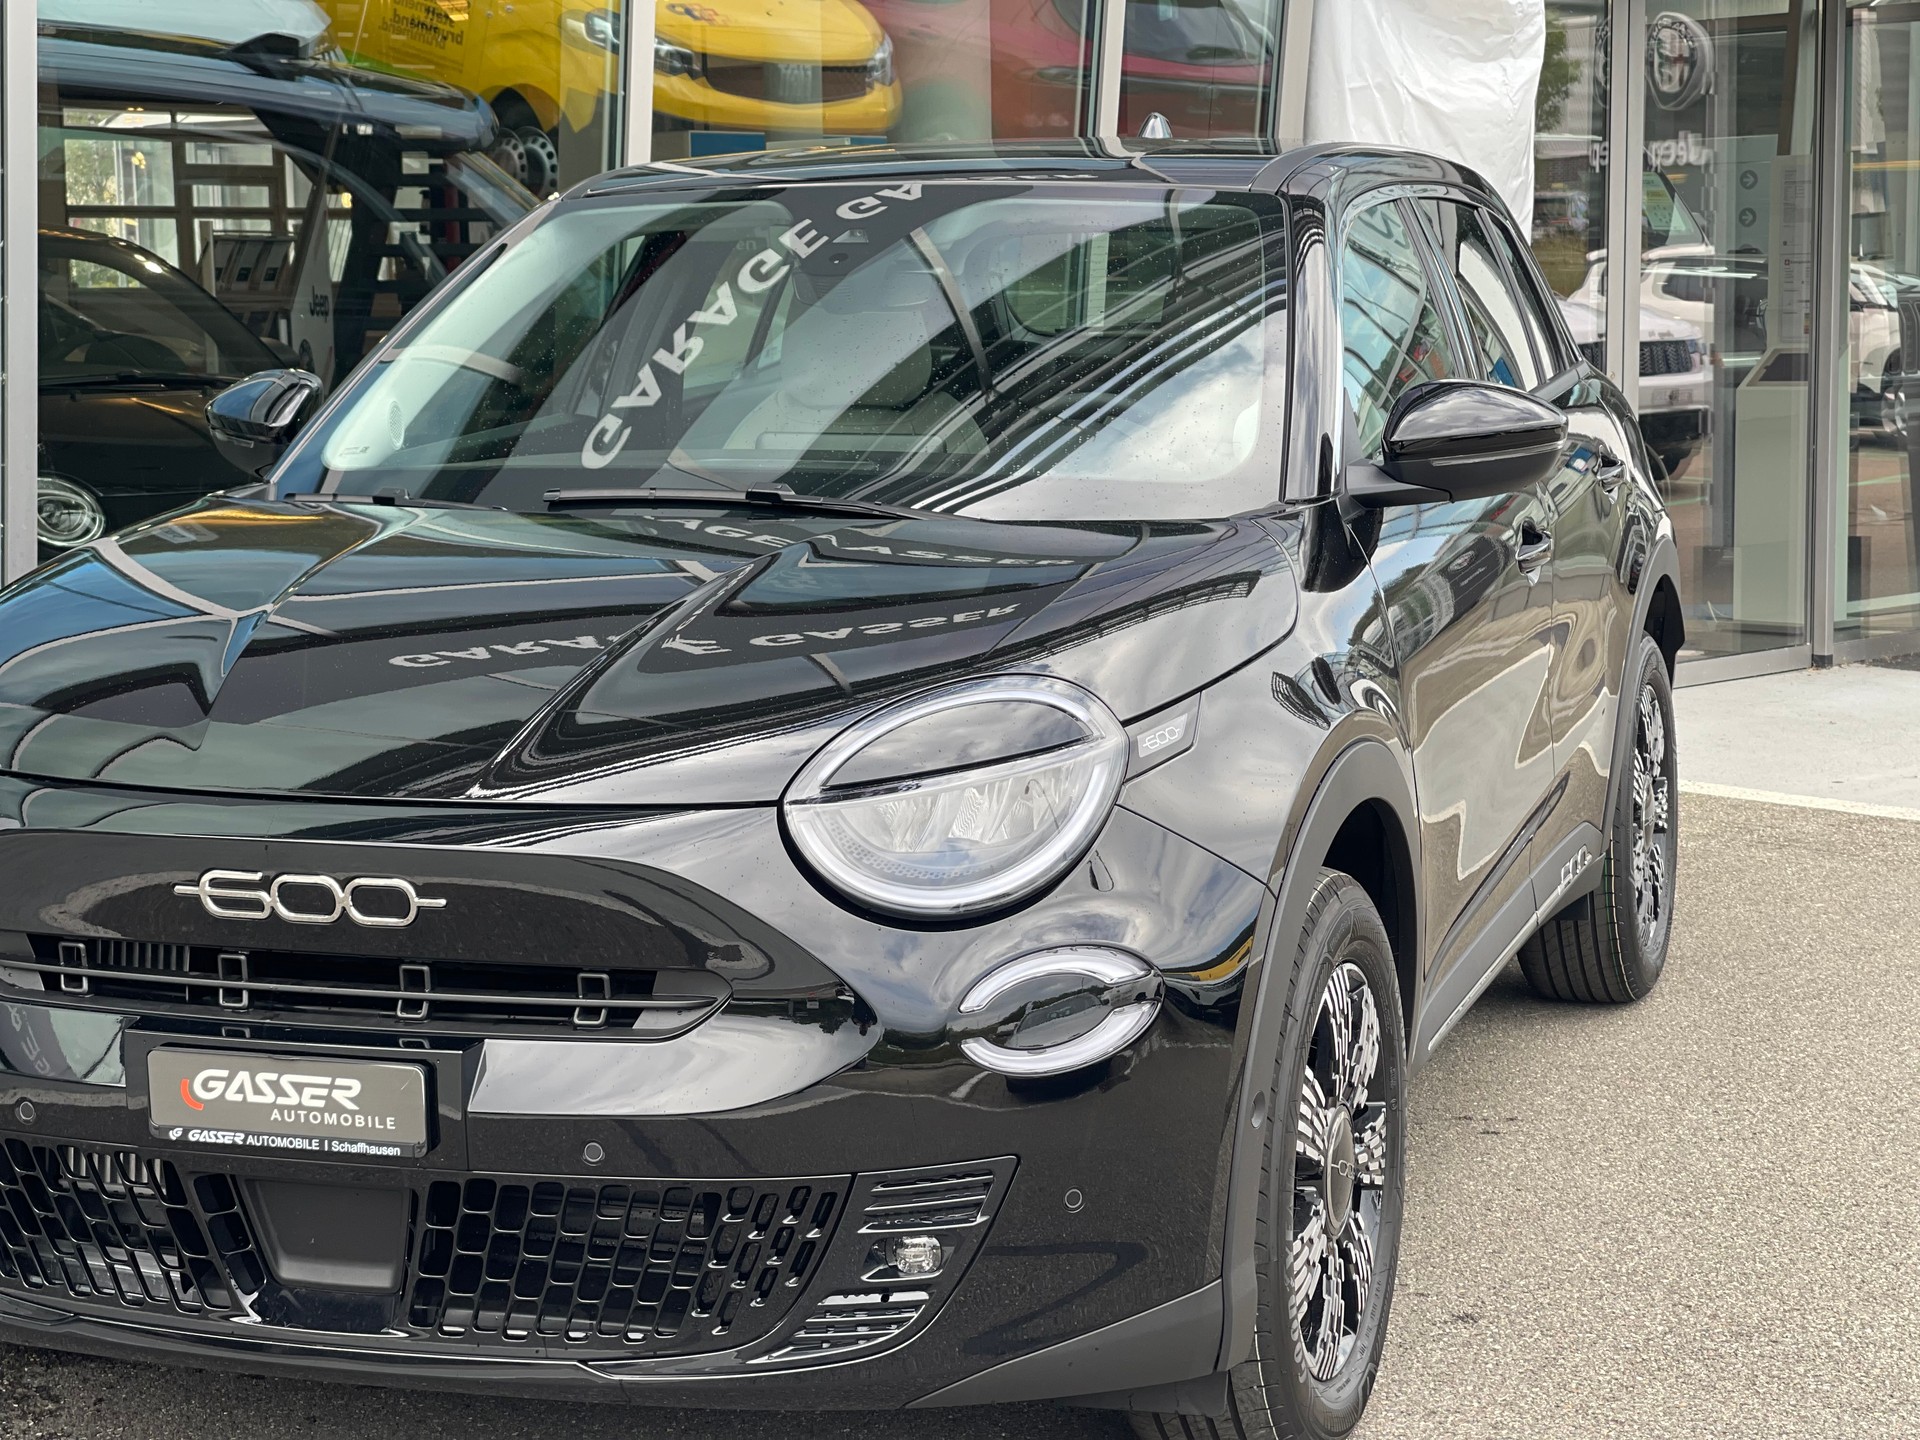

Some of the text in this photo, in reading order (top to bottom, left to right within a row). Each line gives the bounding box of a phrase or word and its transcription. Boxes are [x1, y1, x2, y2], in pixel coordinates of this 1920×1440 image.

[1143, 726, 1181, 750] 600
[190, 869, 430, 928] 600
[193, 1068, 362, 1111] GASSER
[270, 1108, 397, 1130] AUTOMOBILE
[188, 1129, 247, 1146] GASSER
[246, 1135, 320, 1151] AUTOMOBILE
[331, 1140, 401, 1157] Schaffhausen
